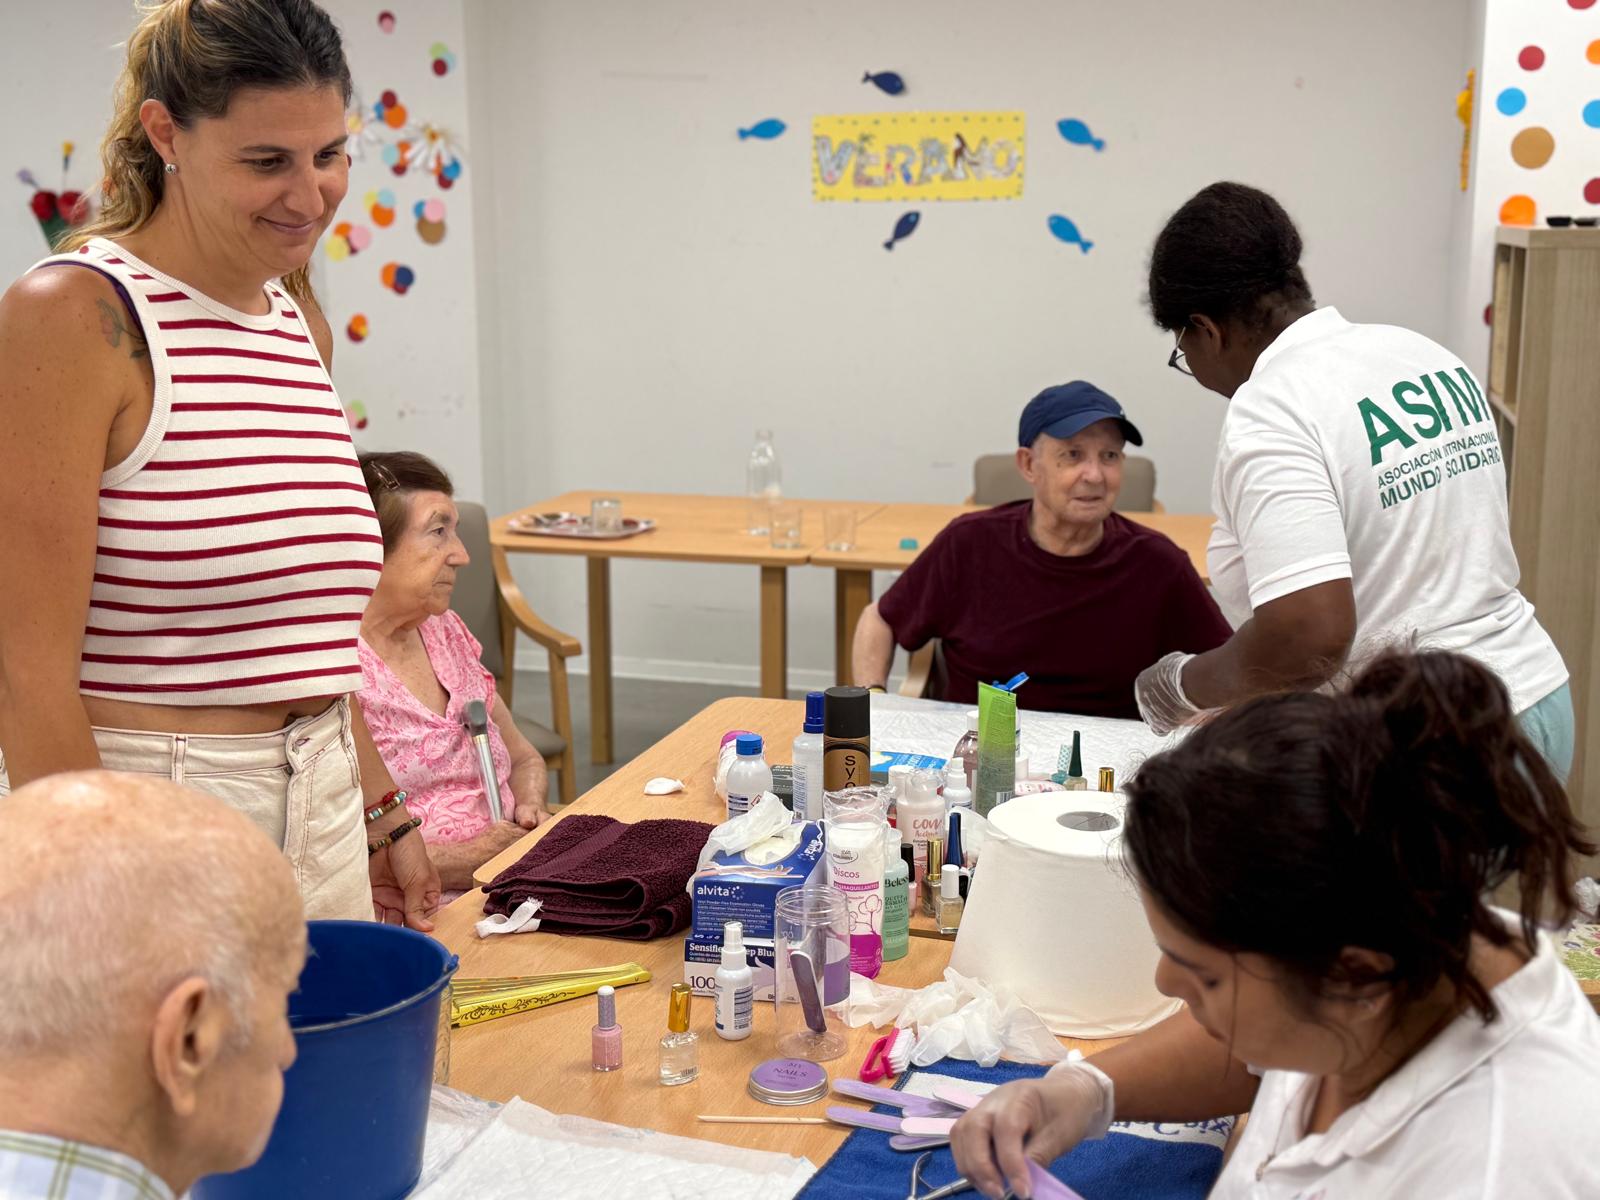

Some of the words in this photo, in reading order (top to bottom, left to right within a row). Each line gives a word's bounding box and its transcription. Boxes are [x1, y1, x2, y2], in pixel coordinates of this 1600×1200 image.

[814, 132, 1019, 186] VERANO
[1357, 366, 1491, 467] ASIM
[1378, 447, 1443, 490] ASOCIACIÓN
[1442, 431, 1497, 458] INTRNACIONAL
[1380, 466, 1442, 510] MUNDO
[697, 884, 730, 897] alvita
[689, 942, 722, 953] Sensifle
[689, 975, 716, 989] 100
